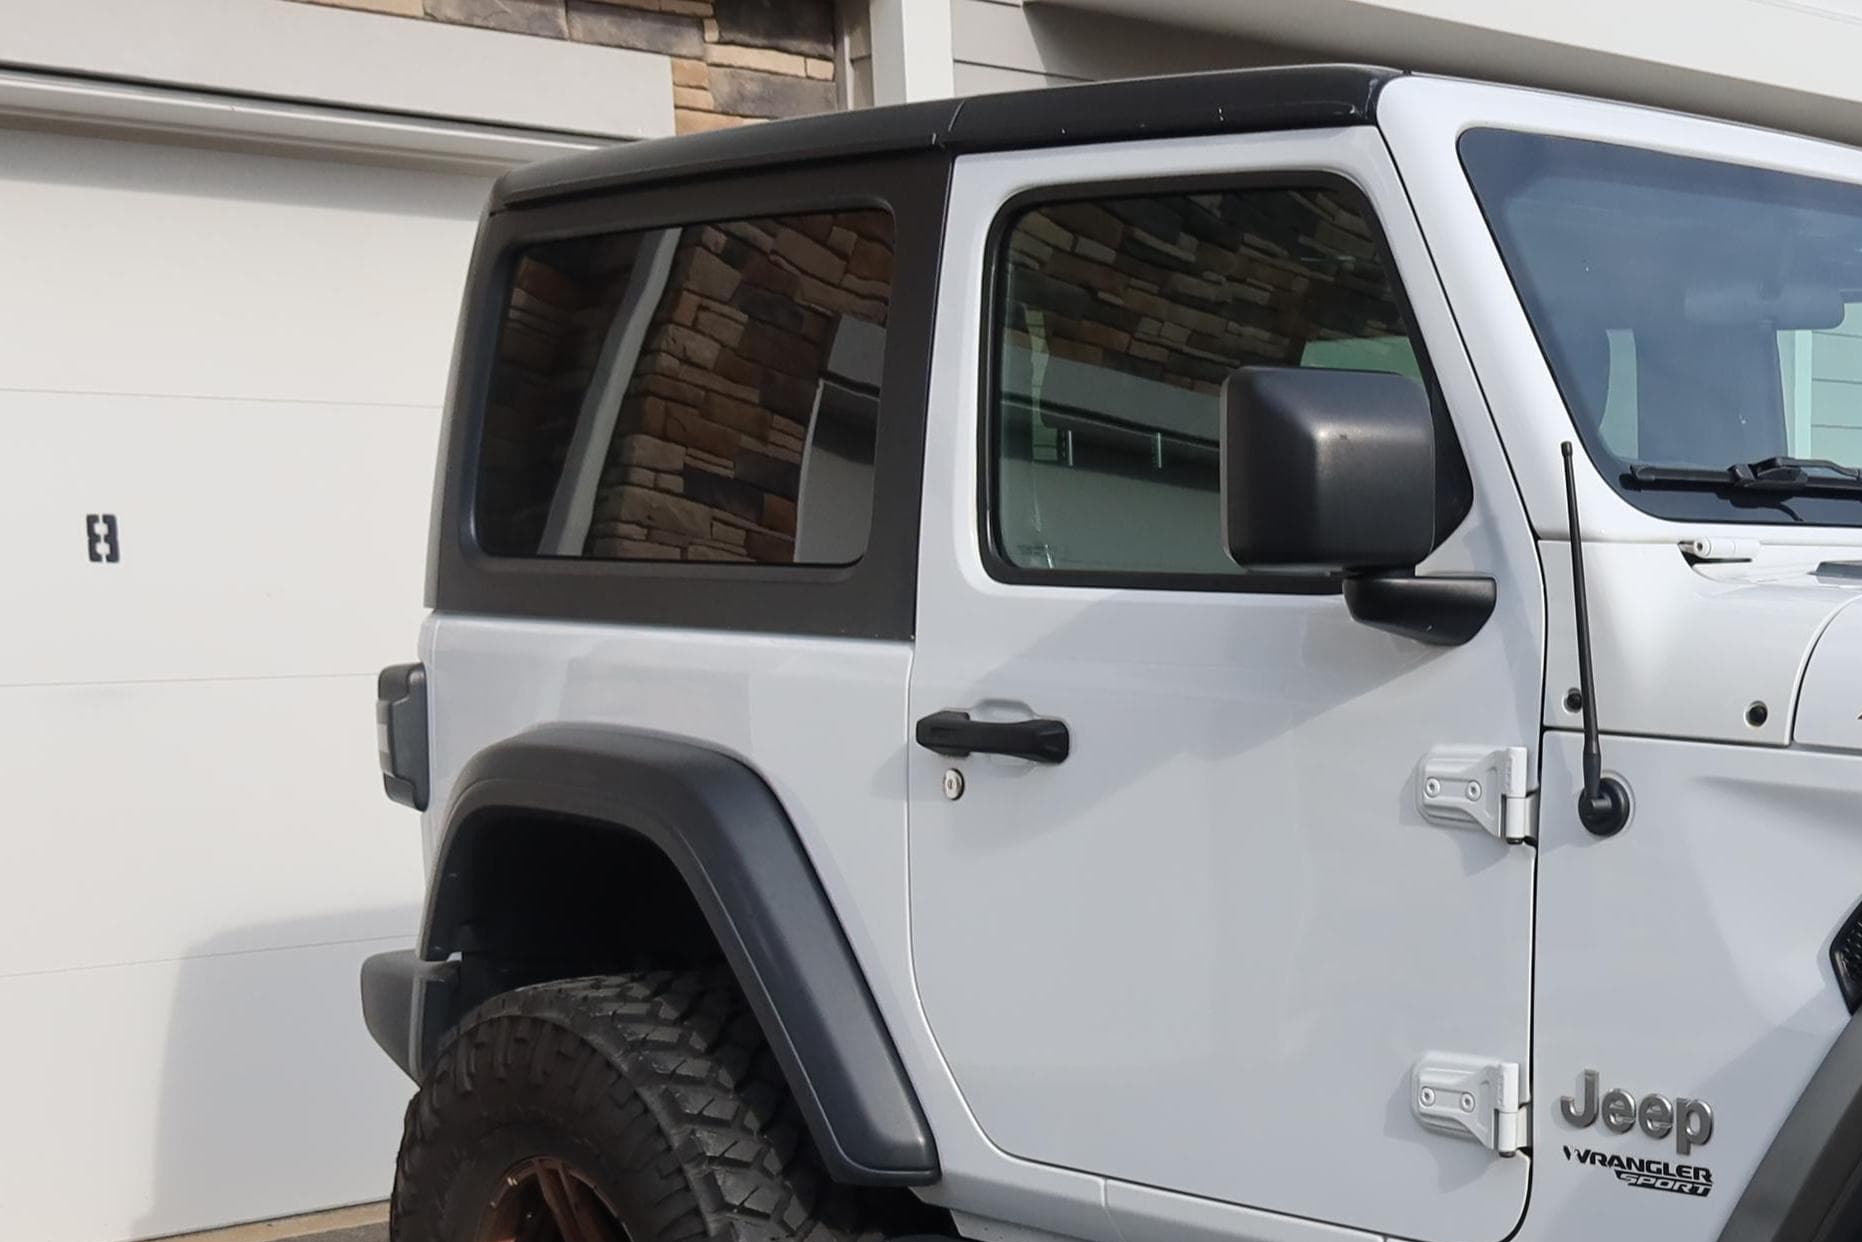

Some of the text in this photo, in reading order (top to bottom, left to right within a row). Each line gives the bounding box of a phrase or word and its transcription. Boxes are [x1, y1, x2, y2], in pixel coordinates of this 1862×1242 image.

[86, 514, 120, 563] 8
[1559, 1068, 1714, 1156] Jeep
[1563, 1145, 1713, 1184] WRANGLER
[1617, 1171, 1712, 1196] SPORT
